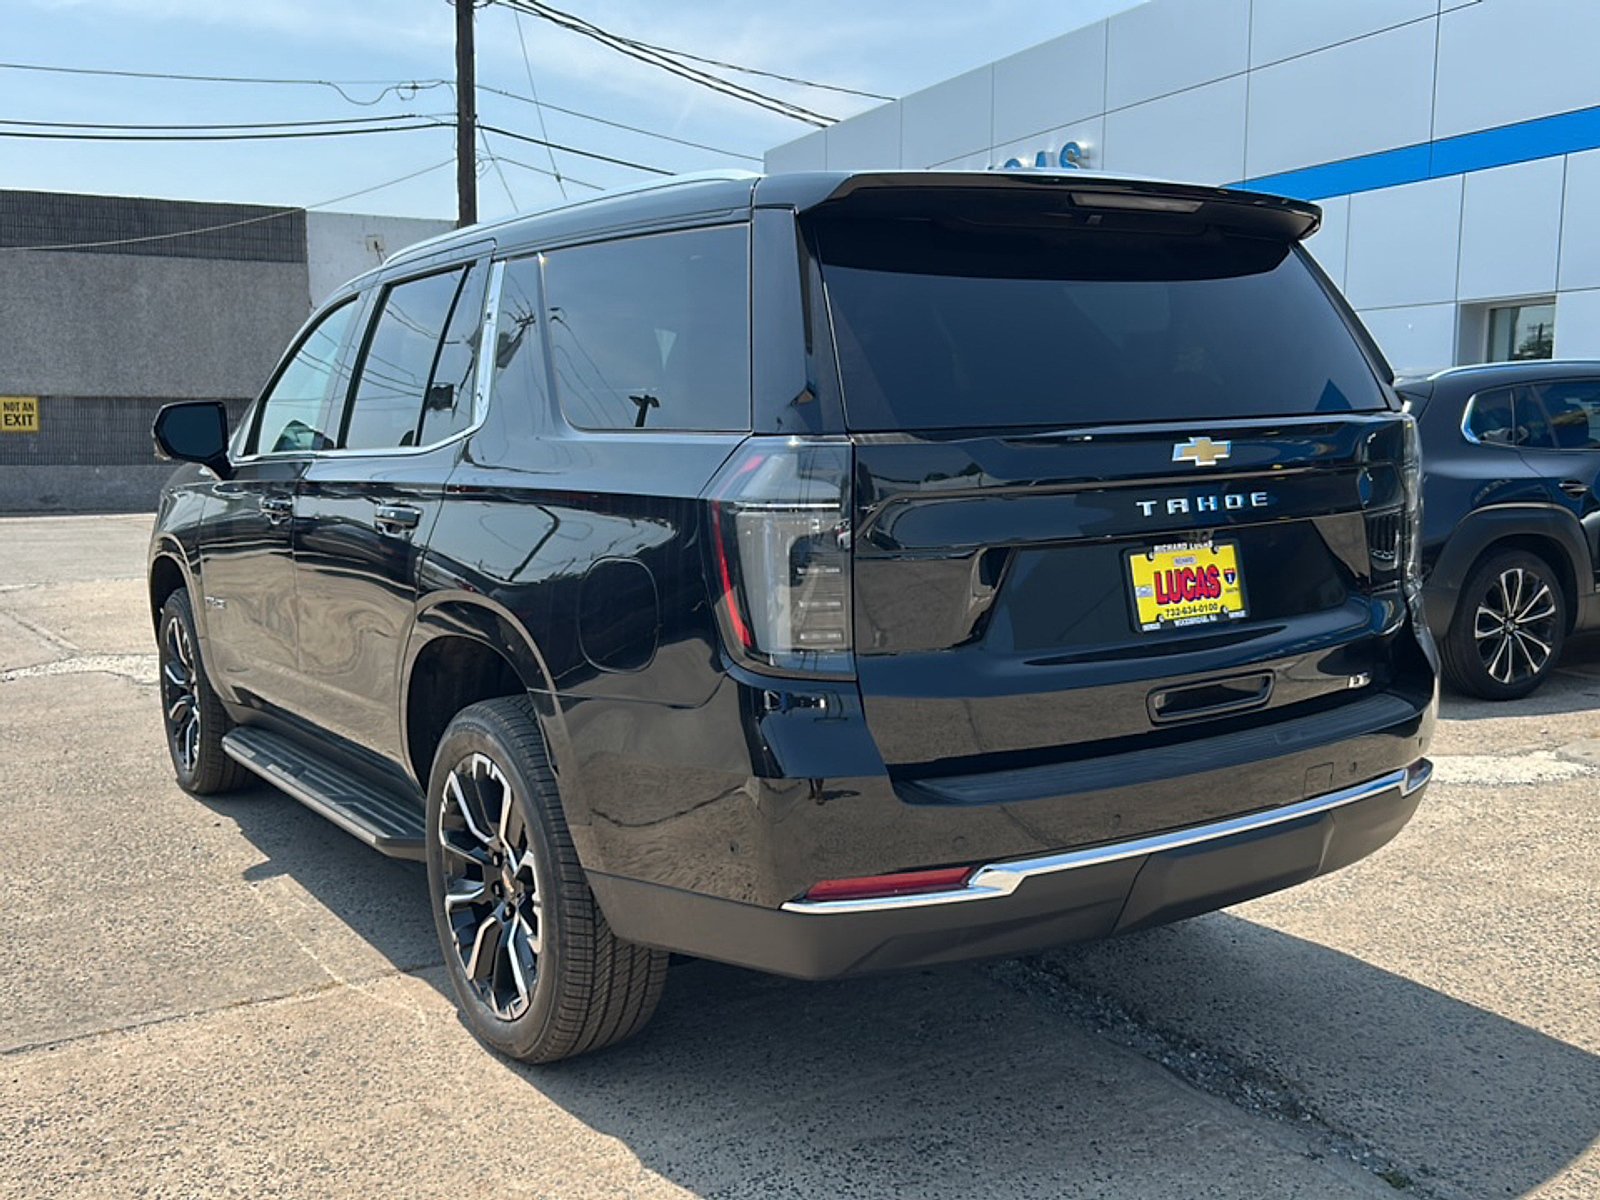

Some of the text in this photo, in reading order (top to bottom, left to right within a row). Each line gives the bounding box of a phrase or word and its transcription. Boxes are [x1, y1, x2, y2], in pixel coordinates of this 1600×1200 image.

[3, 401, 34, 412] NOT AN
[3, 413, 34, 426] EXIT
[1135, 491, 1269, 517] TAHOE
[1153, 565, 1221, 606] LUCAS
